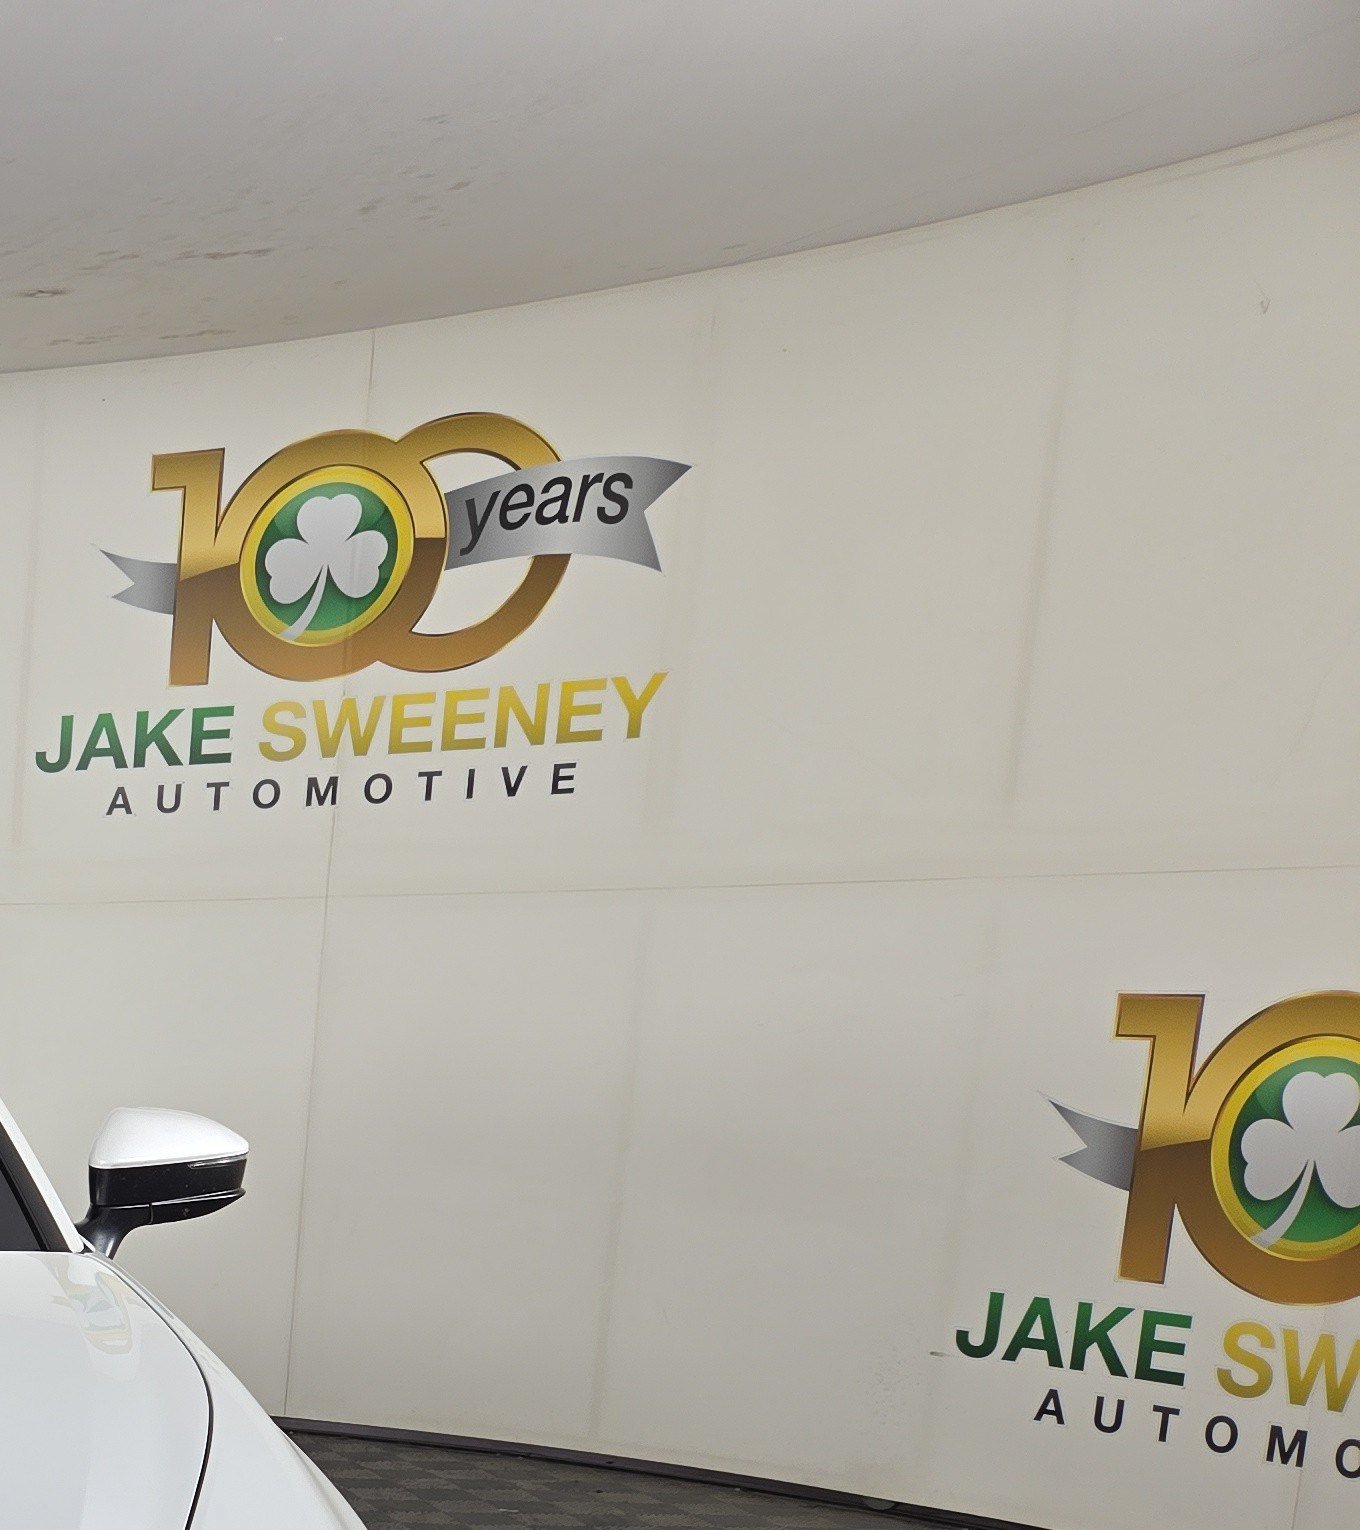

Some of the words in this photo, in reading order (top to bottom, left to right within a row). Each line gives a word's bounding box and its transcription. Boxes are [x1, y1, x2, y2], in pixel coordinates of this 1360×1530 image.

[151, 412, 572, 687] 100
[458, 469, 633, 557] years
[35, 705, 235, 774] JAKE
[258, 671, 669, 762] SWEENEY
[106, 763, 578, 816] AUTOMOTIVE
[955, 1291, 1193, 1387] JAKE
